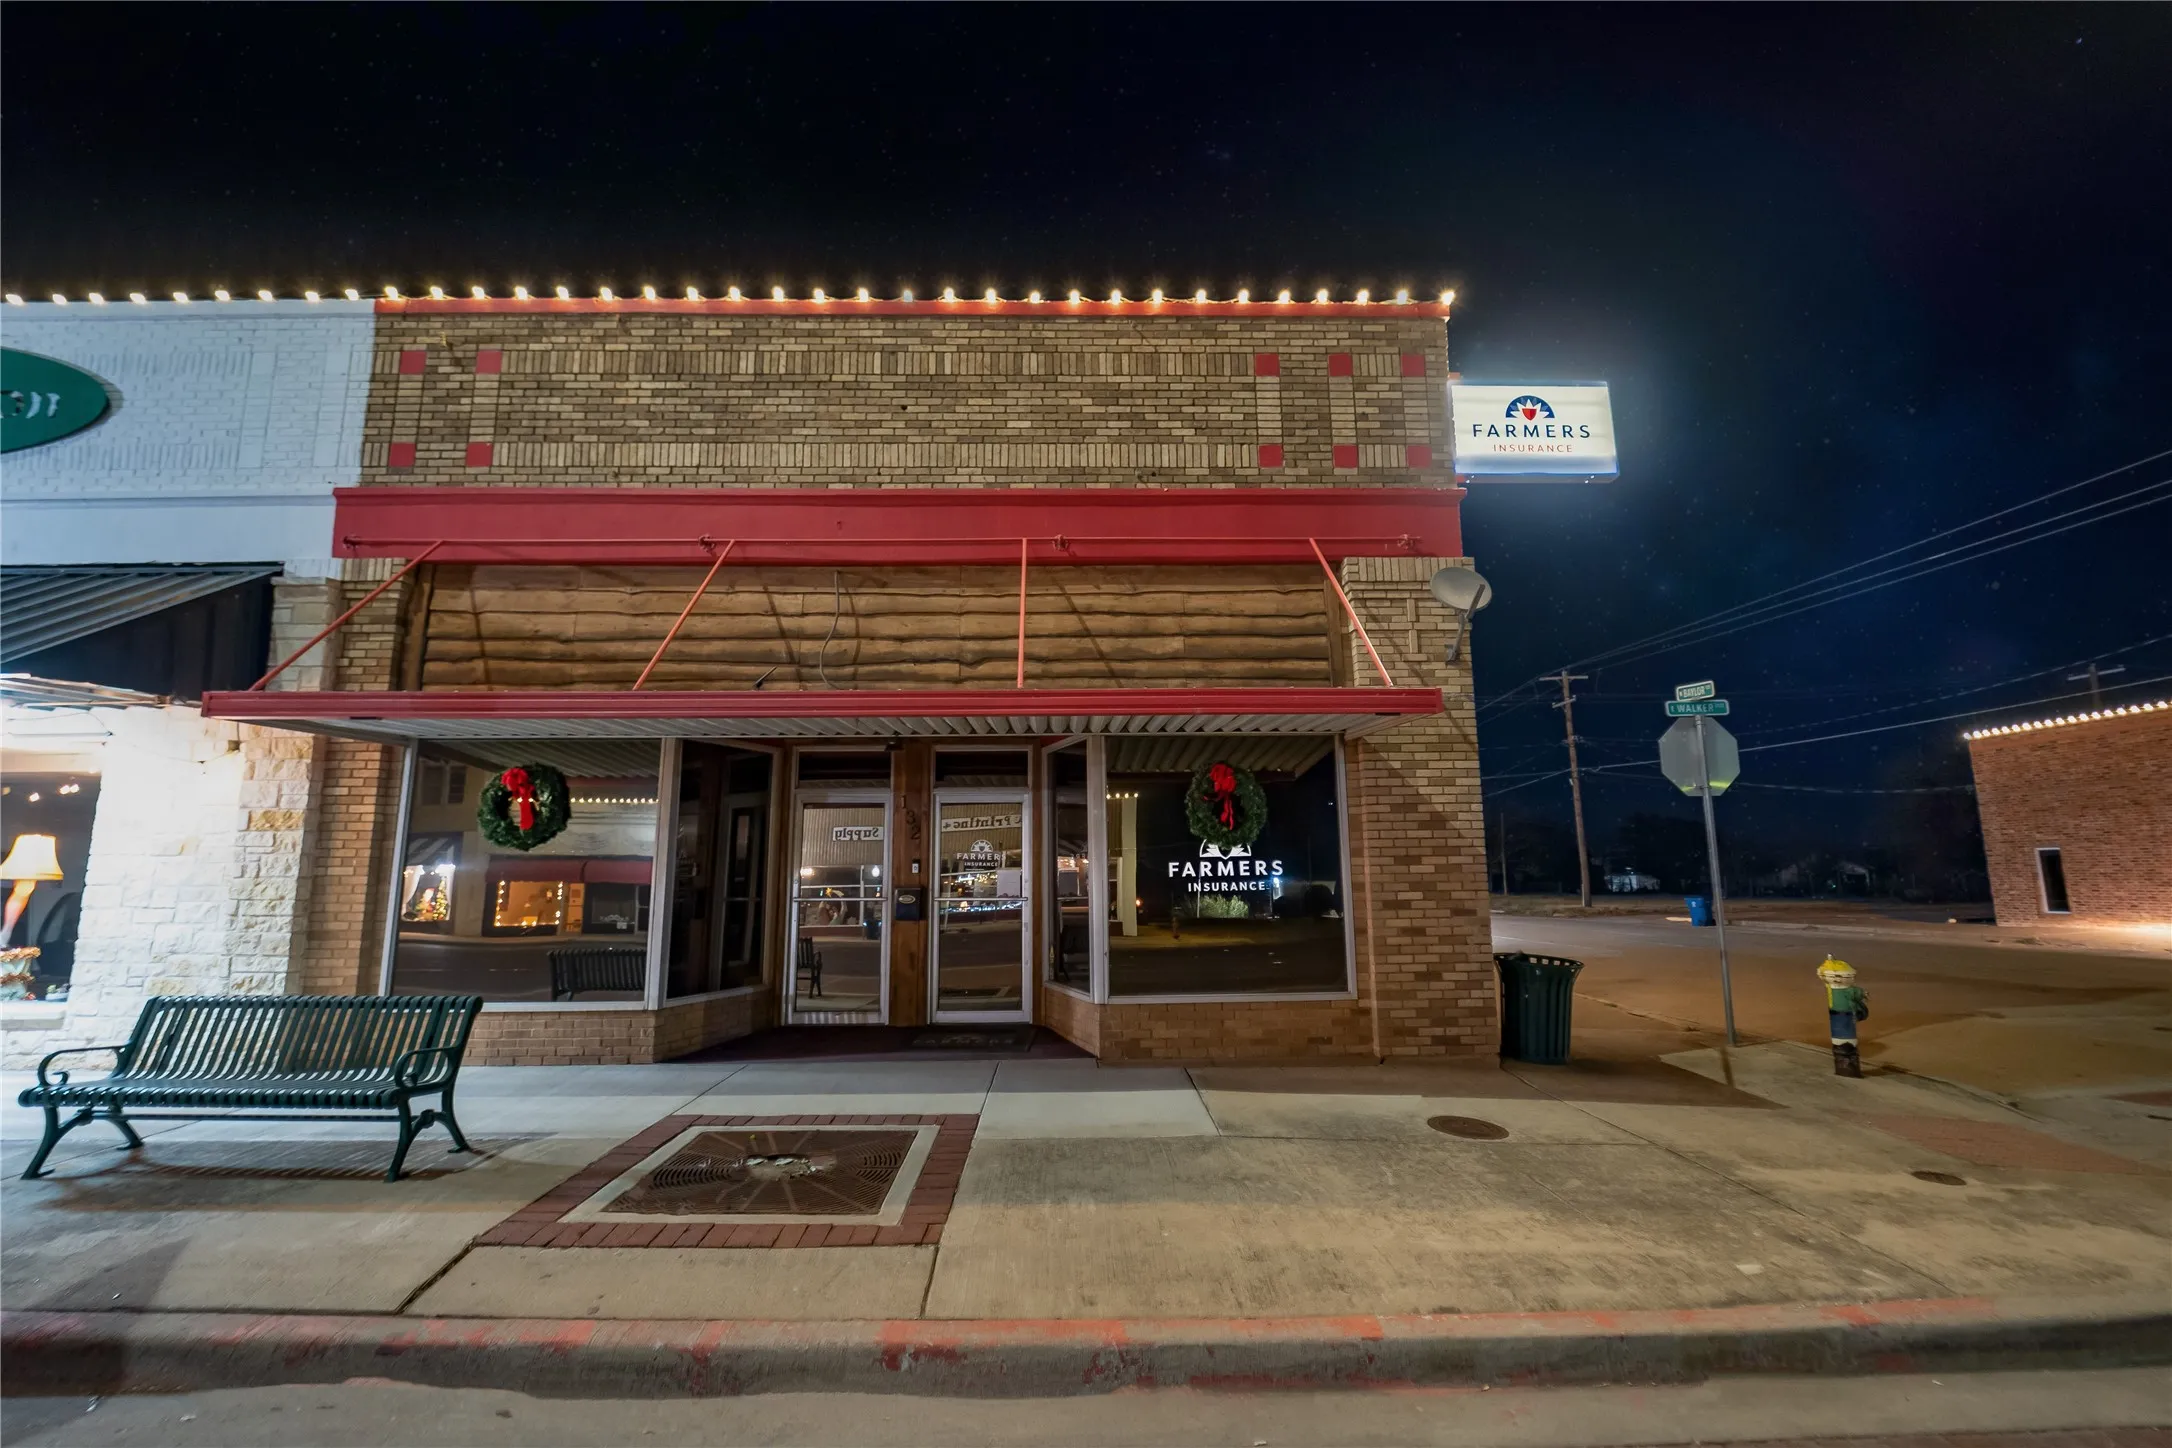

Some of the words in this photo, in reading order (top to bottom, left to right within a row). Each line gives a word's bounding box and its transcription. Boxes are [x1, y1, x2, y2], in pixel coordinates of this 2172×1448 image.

[1472, 424, 1591, 439] FARMERS
[1493, 444, 1573, 453] INSURANCE
[1683, 686, 1705, 697] BAYLOR
[1677, 703, 1714, 713] WALKER
[956, 852, 1006, 861] FARMERS
[1168, 860, 1284, 878] FARMERS
[1188, 881, 1266, 892] INSURANCE
